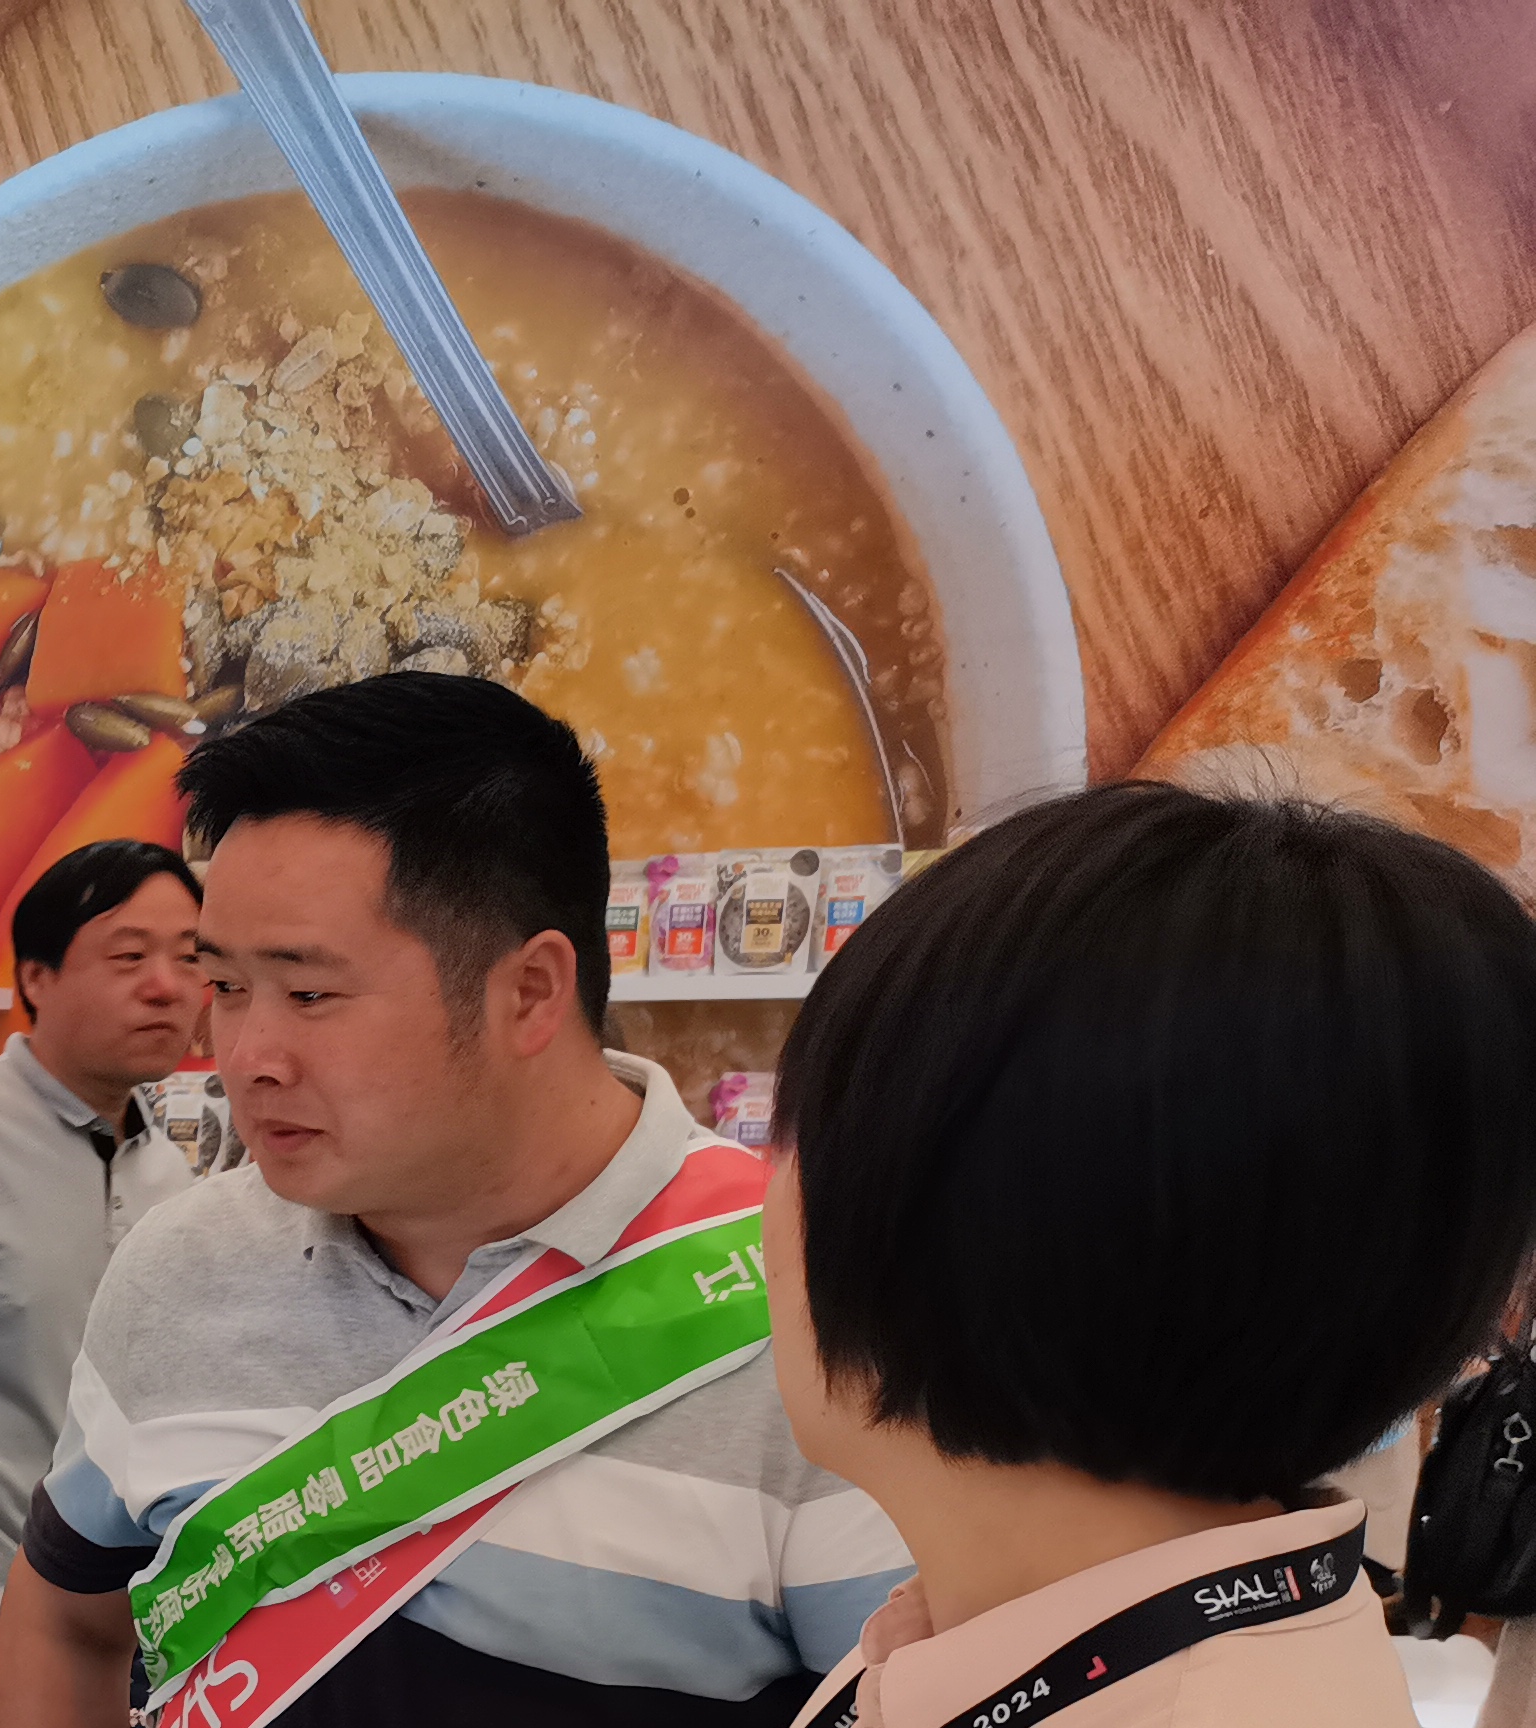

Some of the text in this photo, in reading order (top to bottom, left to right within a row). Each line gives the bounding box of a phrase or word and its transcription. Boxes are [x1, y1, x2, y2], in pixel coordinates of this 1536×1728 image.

[351, 1361, 540, 1492] 绿色食品
[1193, 1573, 1278, 1615] SIAL
